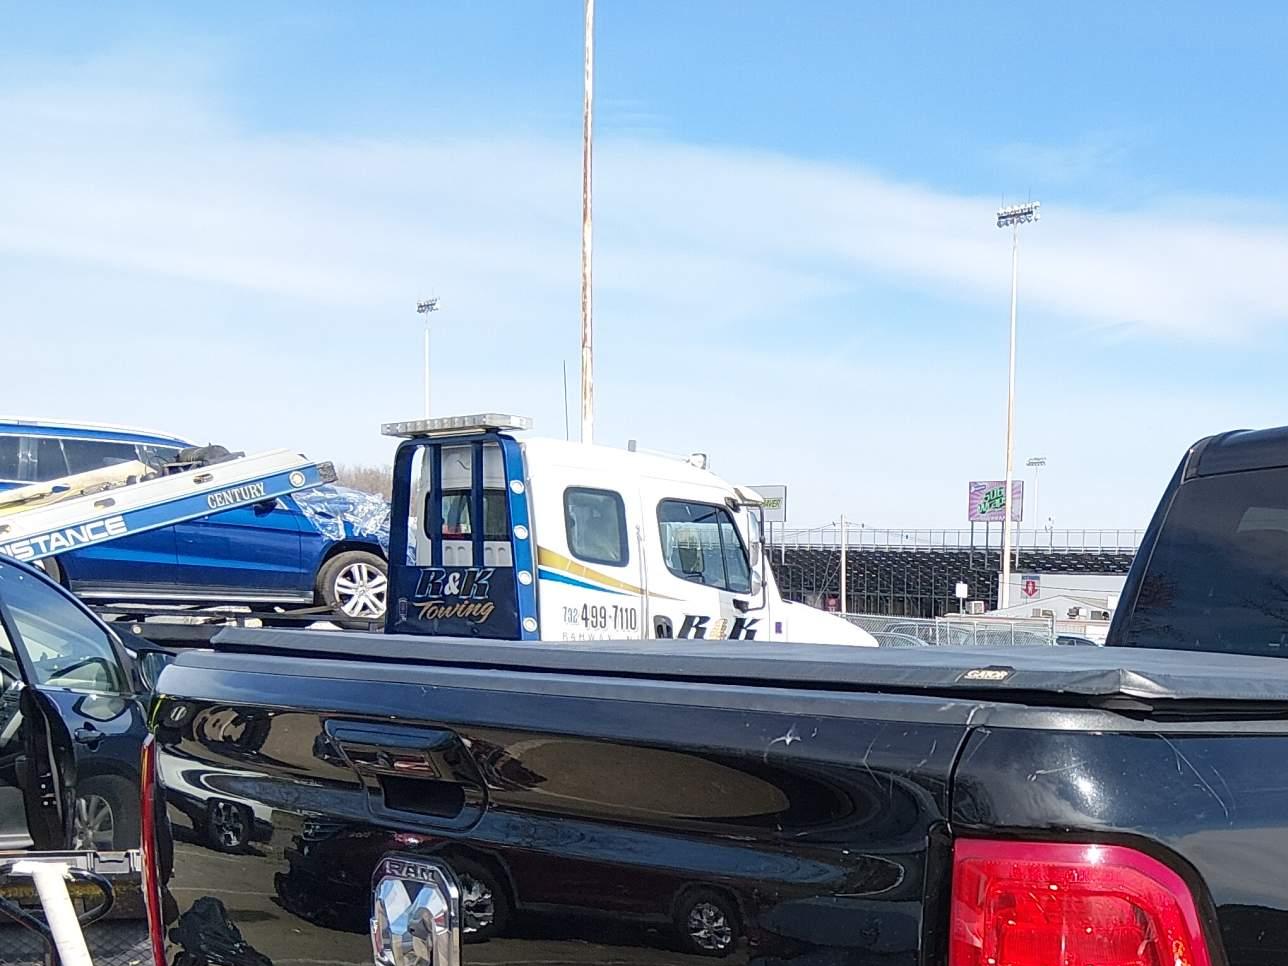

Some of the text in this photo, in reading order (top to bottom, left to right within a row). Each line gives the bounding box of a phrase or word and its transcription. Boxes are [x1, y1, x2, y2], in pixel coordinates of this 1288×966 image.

[207, 482, 266, 509] CENTURY
[0, 514, 128, 560] ISTANCE
[414, 567, 497, 599] R&K
[412, 600, 495, 624] Towing
[562, 606, 578, 623] 732
[385, 860, 436, 882] RAM
